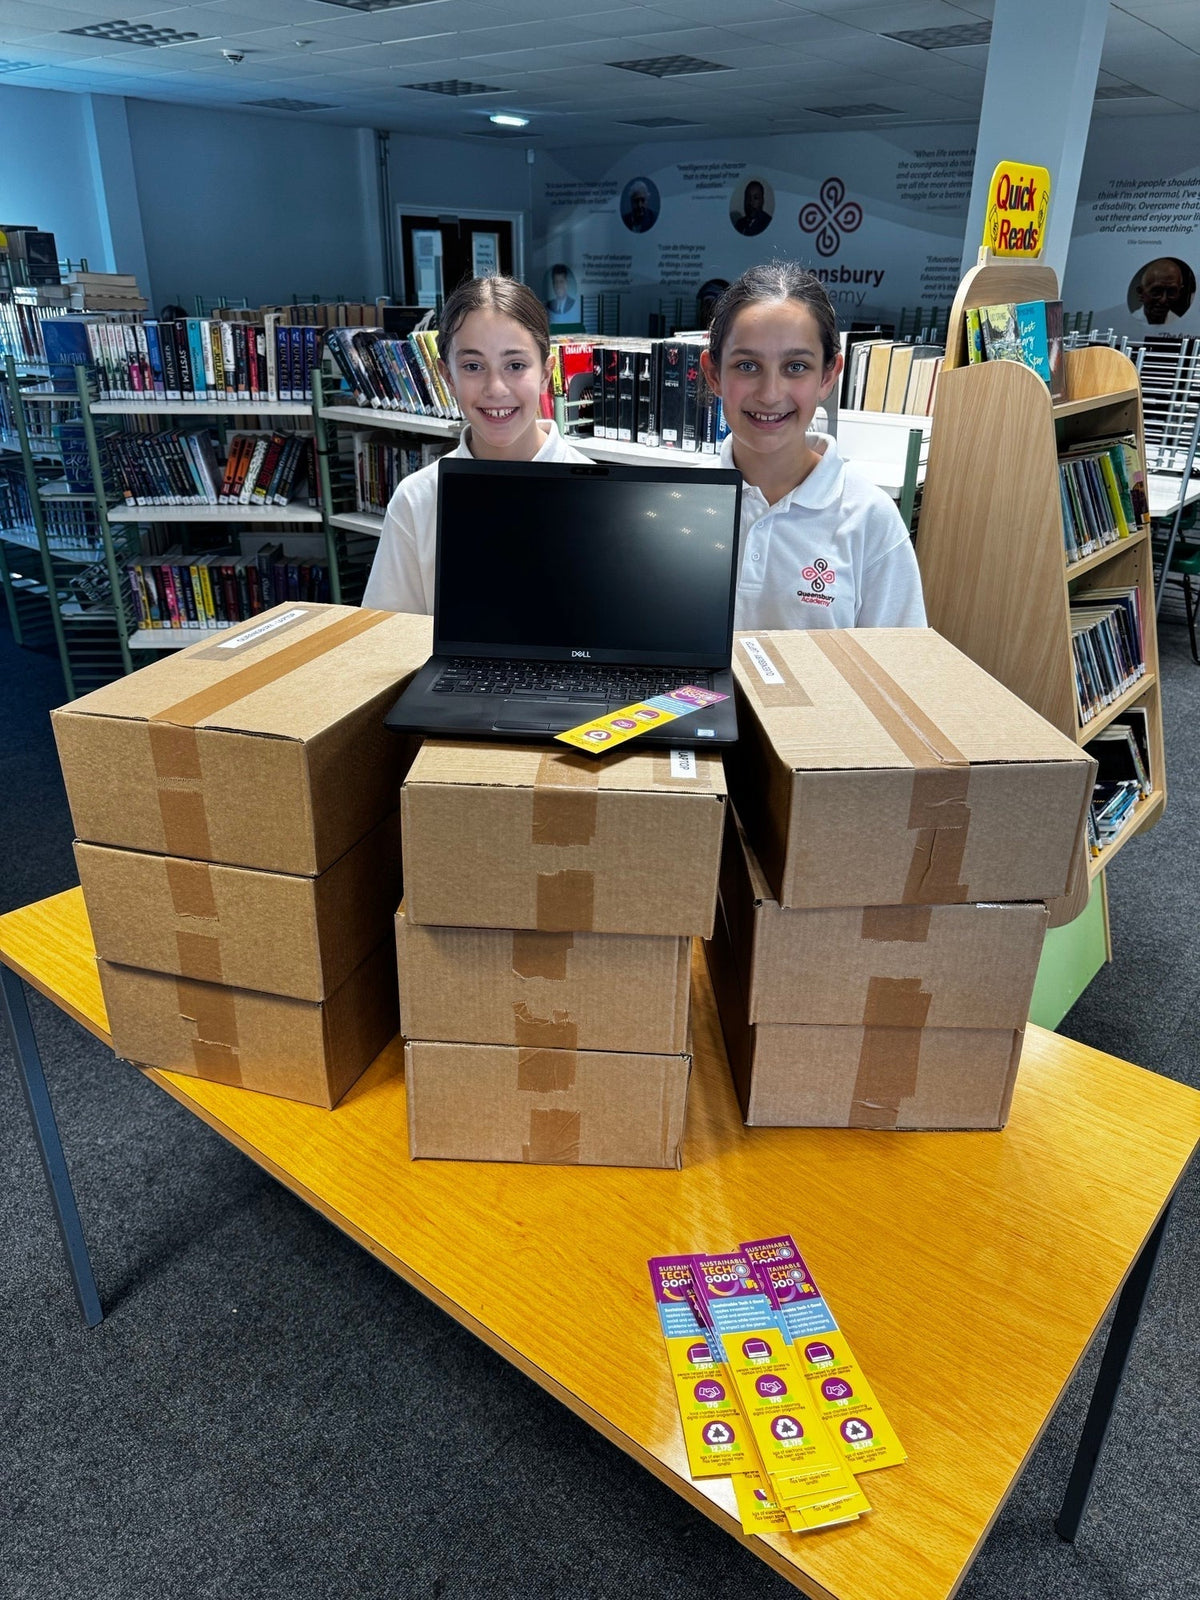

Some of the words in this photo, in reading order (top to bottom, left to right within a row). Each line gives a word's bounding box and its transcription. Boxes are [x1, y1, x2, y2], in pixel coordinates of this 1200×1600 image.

[1116, 179, 1136, 188] think
[1137, 179, 1166, 190] people
[997, 174, 1037, 212] Quick
[1097, 191, 1119, 200] think
[1120, 190, 1133, 199] I'm
[1133, 190, 1149, 199] not
[1182, 190, 1198, 198] I've
[1138, 201, 1180, 210] Overcome
[1095, 214, 1109, 222] out
[1110, 213, 1131, 221] there
[1131, 213, 1150, 221] and
[1150, 214, 1173, 224] enjoy
[1173, 214, 1193, 223] your
[1099, 224, 1116, 233] and
[1116, 224, 1148, 233] achieve
[999, 220, 1038, 250] Reads
[179, 349, 190, 384] SYSTEM
[797, 590, 836, 603] Queensbury
[801, 597, 831, 607] Academy
[571, 650, 591, 658] DELL
[745, 1241, 790, 1253] SUSTAINABLE
[749, 1248, 777, 1261] TECH
[700, 1257, 747, 1268] SUSTAINABLE
[768, 1262, 802, 1273] TAINABLE
[659, 1264, 691, 1273] SUSTAIN
[701, 1265, 732, 1277] TECH
[660, 1270, 691, 1281] TECH
[705, 1273, 739, 1284] GOOD
[770, 1271, 788, 1281] CH
[772, 1278, 795, 1289] OOD
